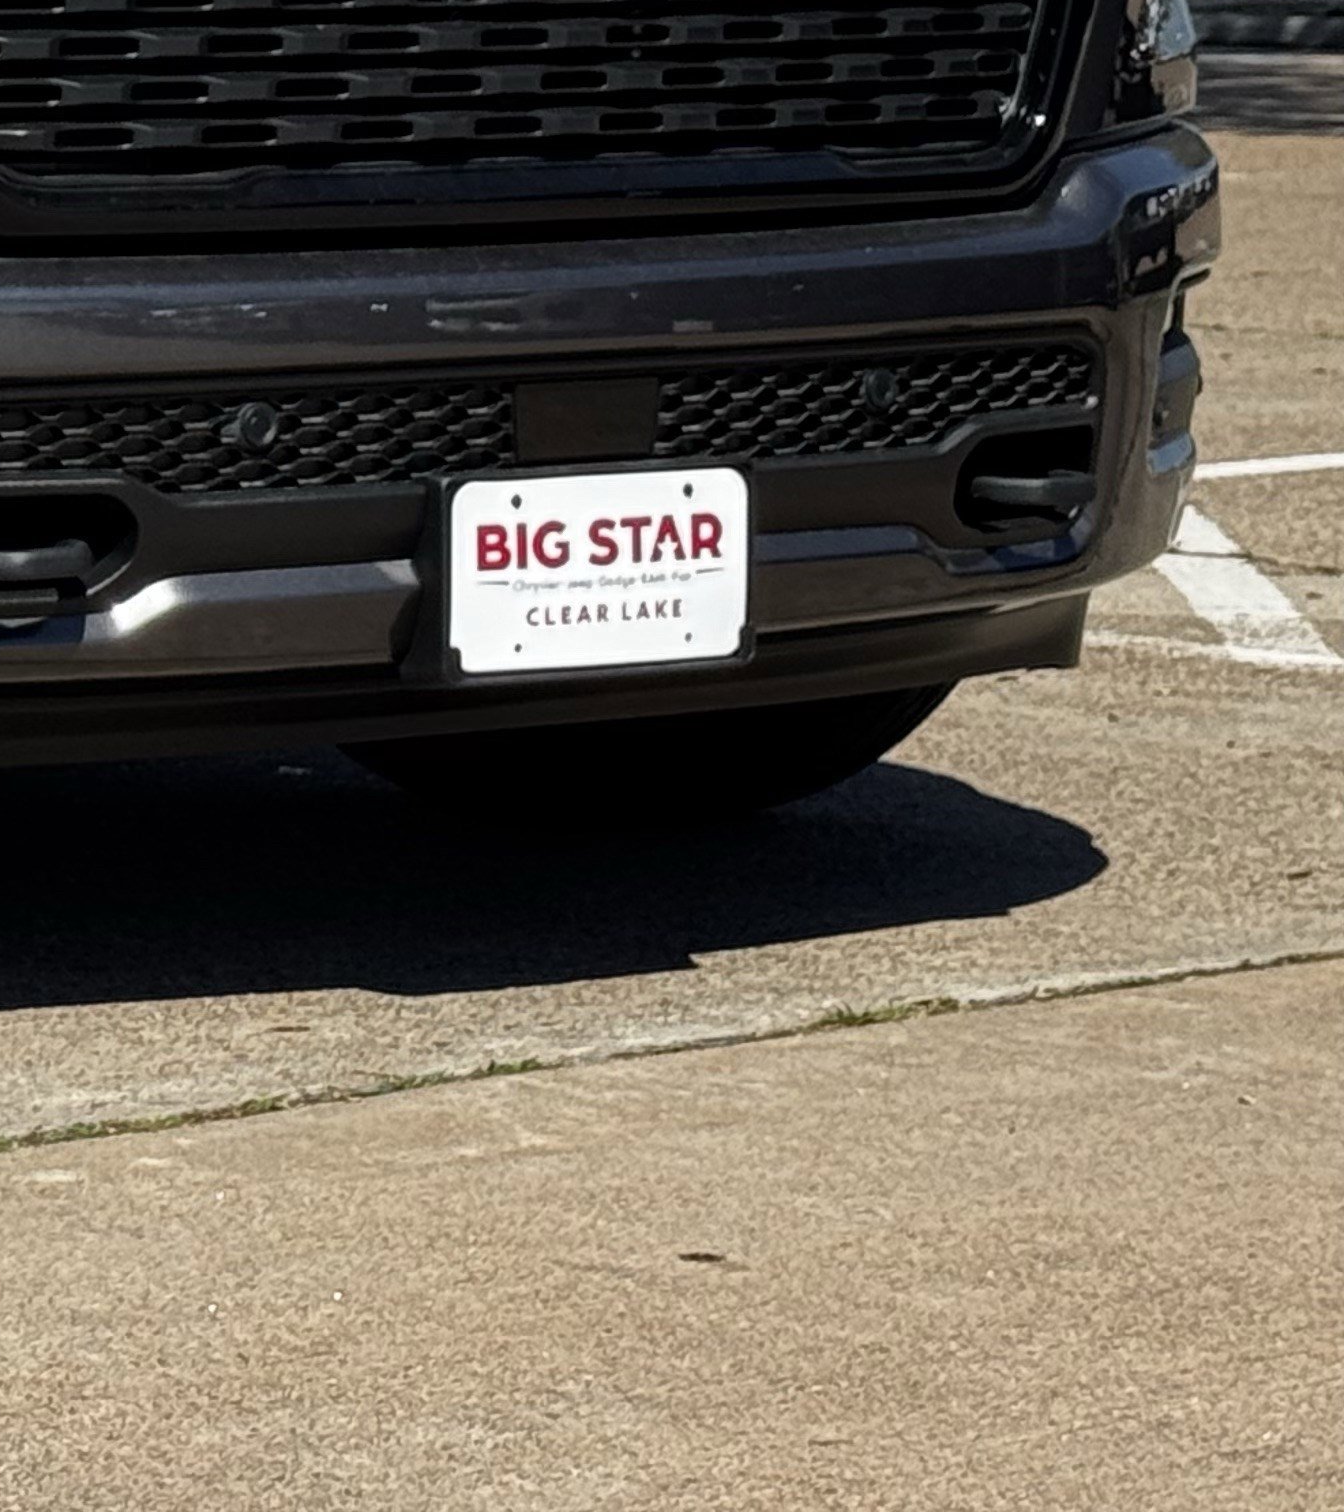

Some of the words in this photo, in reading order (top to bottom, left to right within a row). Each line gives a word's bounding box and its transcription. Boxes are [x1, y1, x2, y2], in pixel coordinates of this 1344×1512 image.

[476, 520, 570, 571] BIG
[588, 513, 723, 566] STAR
[526, 603, 610, 627] CLEAR
[621, 598, 683, 621] LAKE
